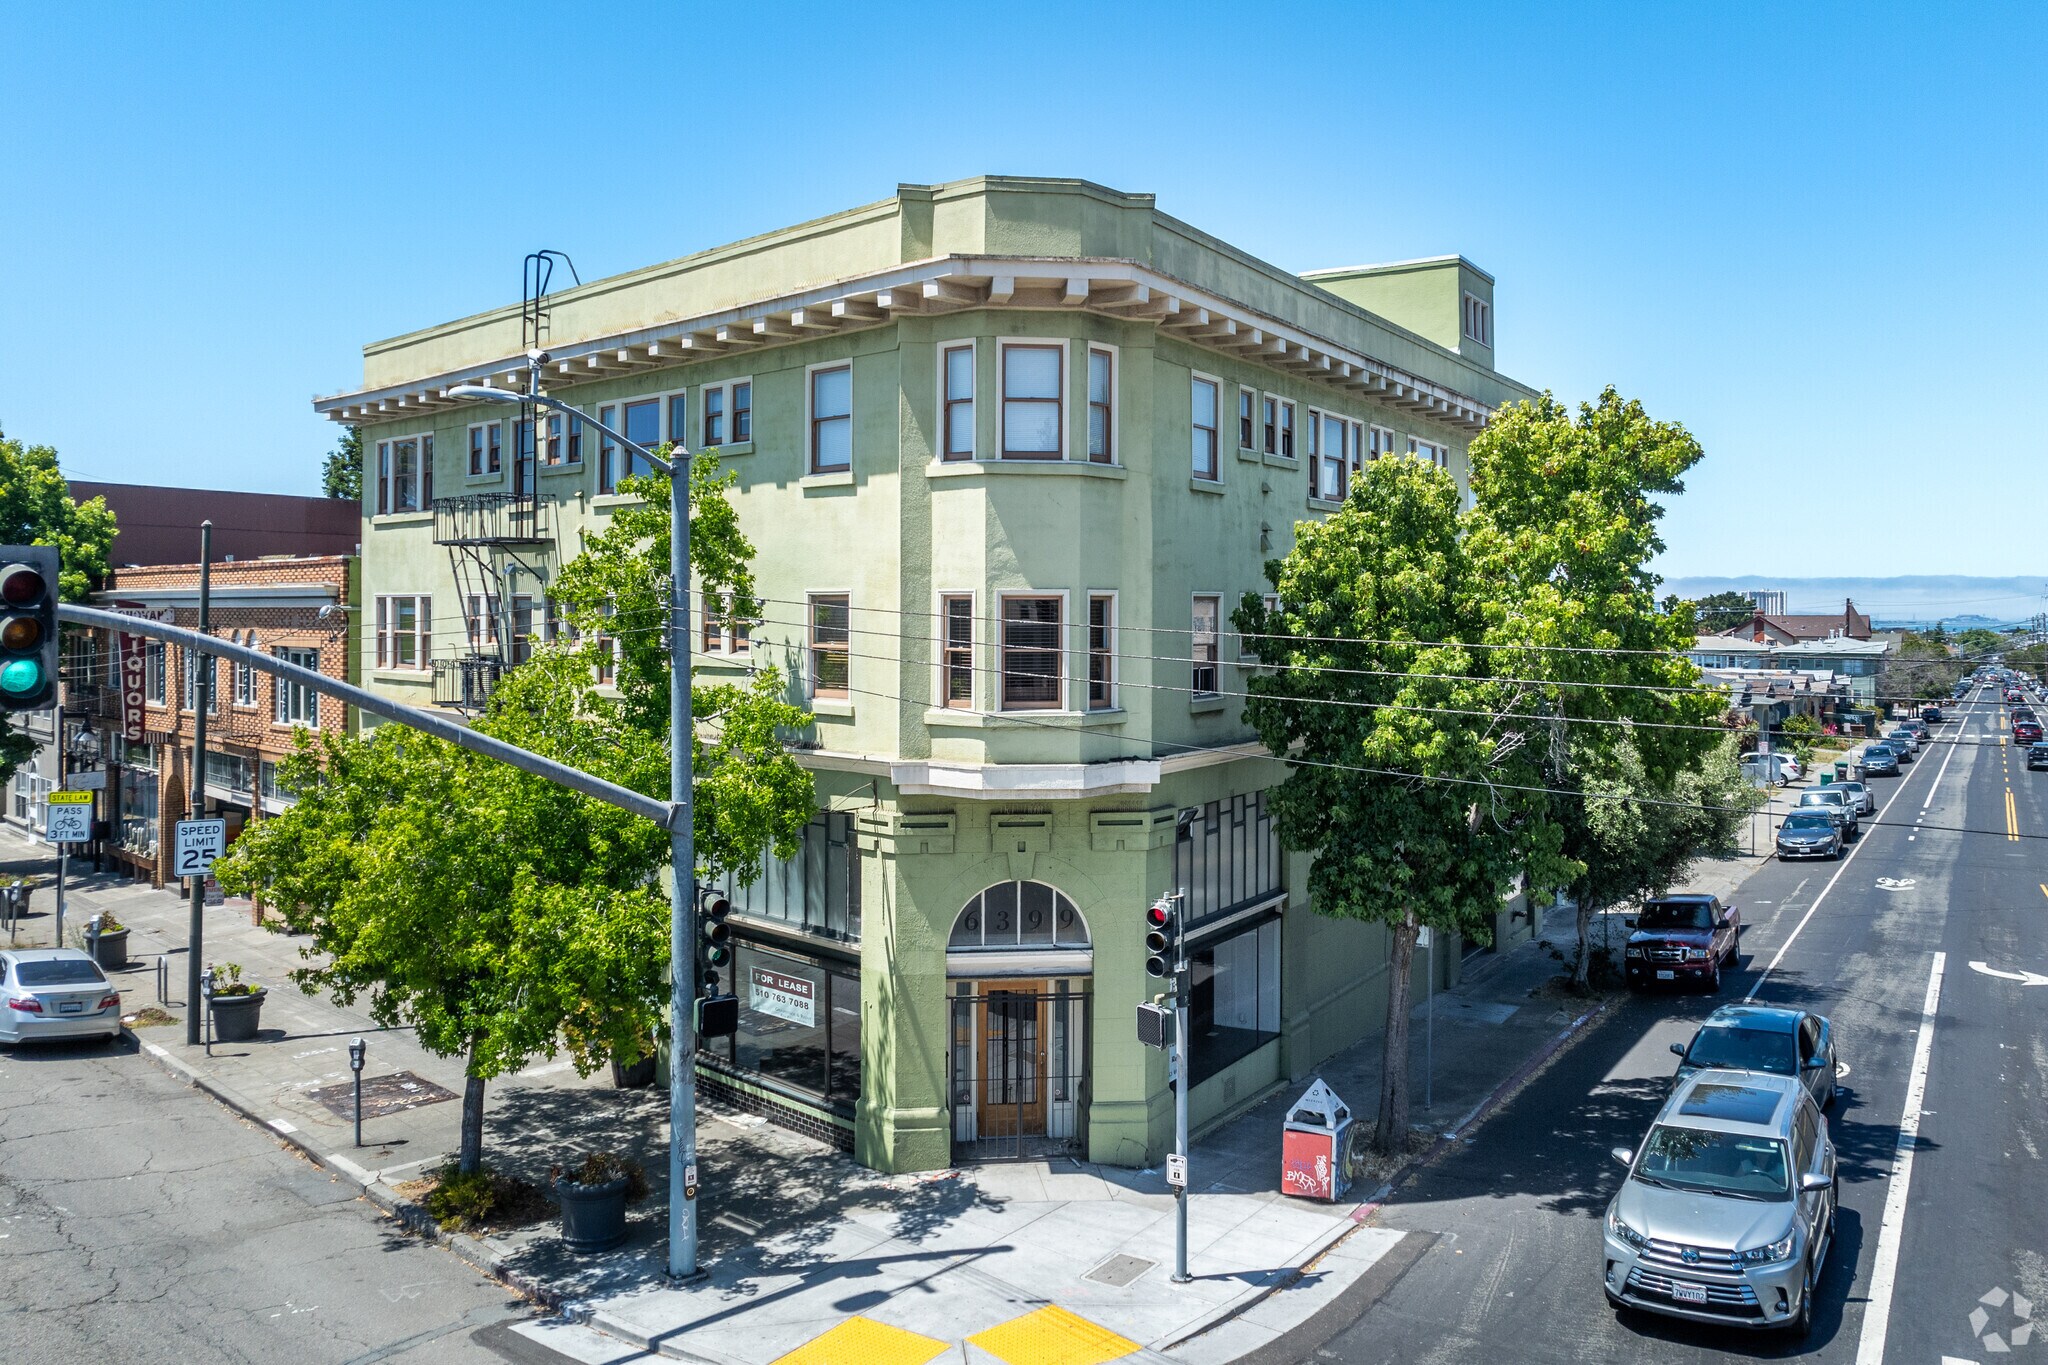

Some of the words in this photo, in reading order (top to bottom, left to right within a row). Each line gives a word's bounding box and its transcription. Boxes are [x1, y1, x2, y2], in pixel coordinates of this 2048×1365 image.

[126, 631, 143, 742] IQUORS
[57, 807, 82, 815] PASS
[50, 830, 58, 839] 3
[60, 830, 69, 839] FT
[72, 830, 85, 838] MIN
[181, 825, 220, 836] SPEED
[184, 837, 216, 848] LIMIT
[182, 848, 217, 870] 25
[964, 909, 1075, 931] 6399
[755, 972, 774, 985] FOR
[778, 978, 808, 994] LEASE
[755, 988, 770, 999] 510
[772, 992, 786, 1004] 763
[788, 997, 809, 1010] 7088
